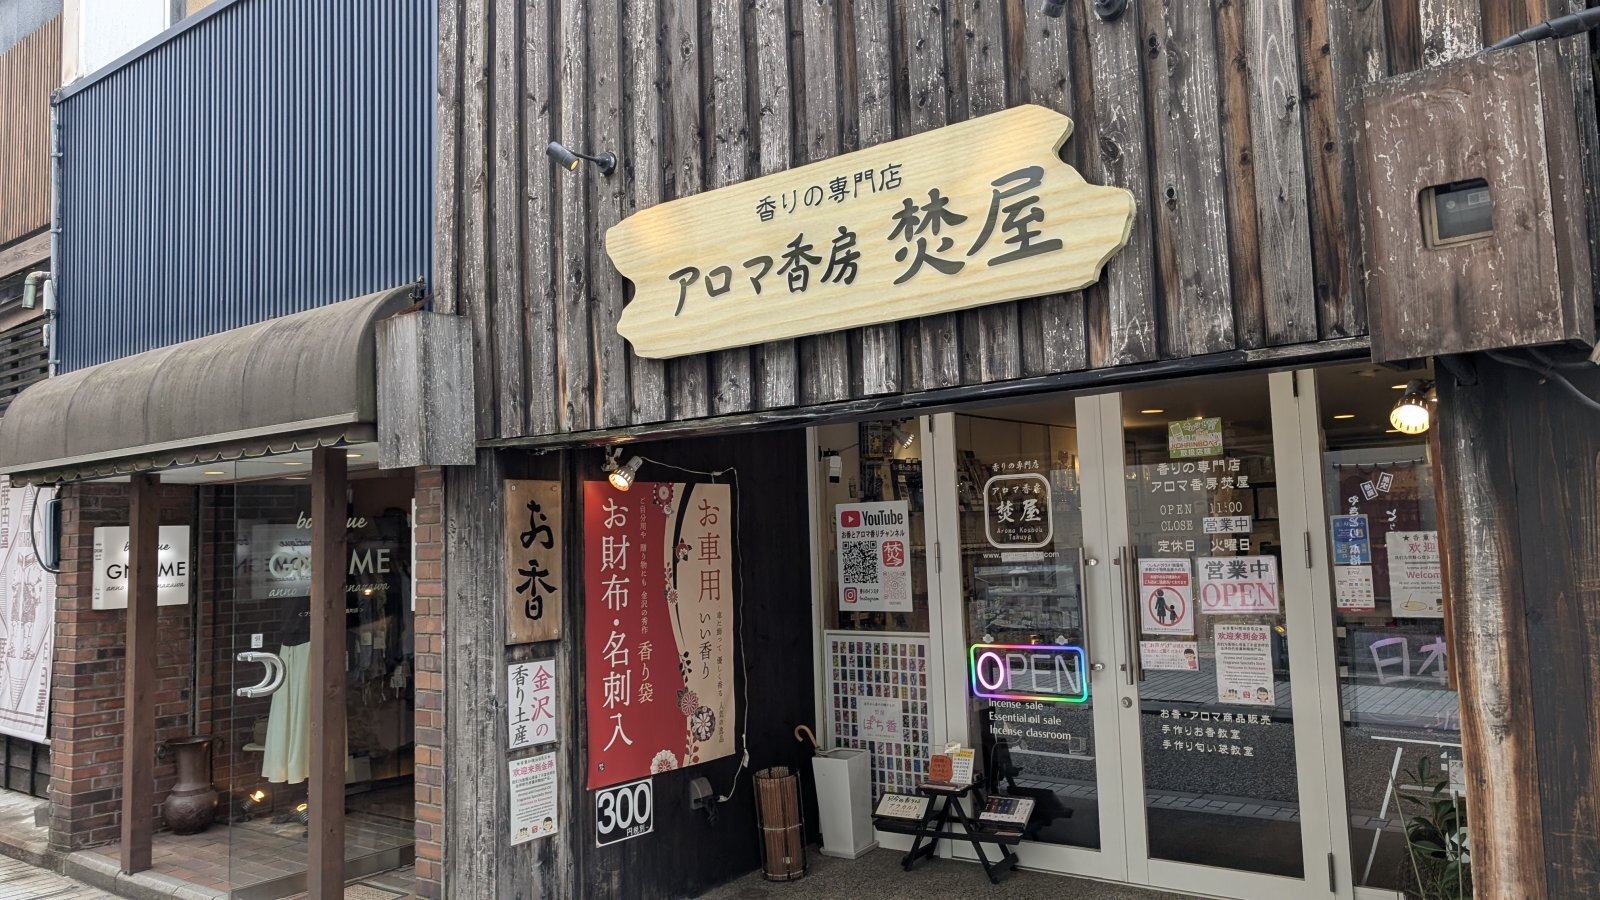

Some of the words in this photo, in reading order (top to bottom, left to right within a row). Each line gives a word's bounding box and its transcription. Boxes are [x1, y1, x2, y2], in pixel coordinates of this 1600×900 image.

[755, 163, 903, 222] 香りの専門店
[668, 225, 861, 317] アロマ香房
[887, 165, 1063, 285] 焚屋
[991, 459, 1040, 472] 香りの専門店
[1156, 458, 1241, 476] 香りの専門店
[1151, 475, 1250, 493] アロマ香房焚屋
[861, 509, 903, 526] YouTube
[996, 498, 1042, 523] 焚屋
[1160, 503, 1192, 516] OPEN
[1209, 501, 1243, 514] 11:00
[841, 529, 905, 539] お香とアロマ香りチャンネル
[1160, 520, 1194, 531] CLOSE
[1204, 517, 1248, 533] 営業中
[698, 498, 721, 603] お車用
[1157, 539, 1195, 552] 定休日
[1211, 538, 1250, 552] 火曜日
[269, 549, 390, 579] GME
[516, 500, 557, 620] お香
[1204, 559, 1270, 580] 営業中
[107, 561, 186, 580] GME
[1202, 581, 1276, 608] OPEN
[600, 497, 634, 752] お財布・名刺入
[699, 612, 712, 680] いい香り
[1217, 632, 1268, 641] 欢迎来到金泽
[637, 640, 654, 704] 香り袋
[977, 651, 1081, 694] OPEN
[511, 665, 530, 746] 香り土産
[531, 665, 555, 737] 金沢の
[988, 698, 1022, 709] Incense
[1025, 701, 1044, 711] sale
[988, 711, 1027, 723] Essential
[1029, 715, 1041, 724] oil
[1043, 715, 1062, 725] sale
[1160, 708, 1271, 726] お香・アロマ商品販売
[989, 724, 1023, 737] Incense
[1025, 728, 1072, 741] classroom
[1161, 724, 1241, 740] 手作りお香教室
[1162, 739, 1255, 757] 手作り匂い袋教室
[597, 783, 651, 835] 300
